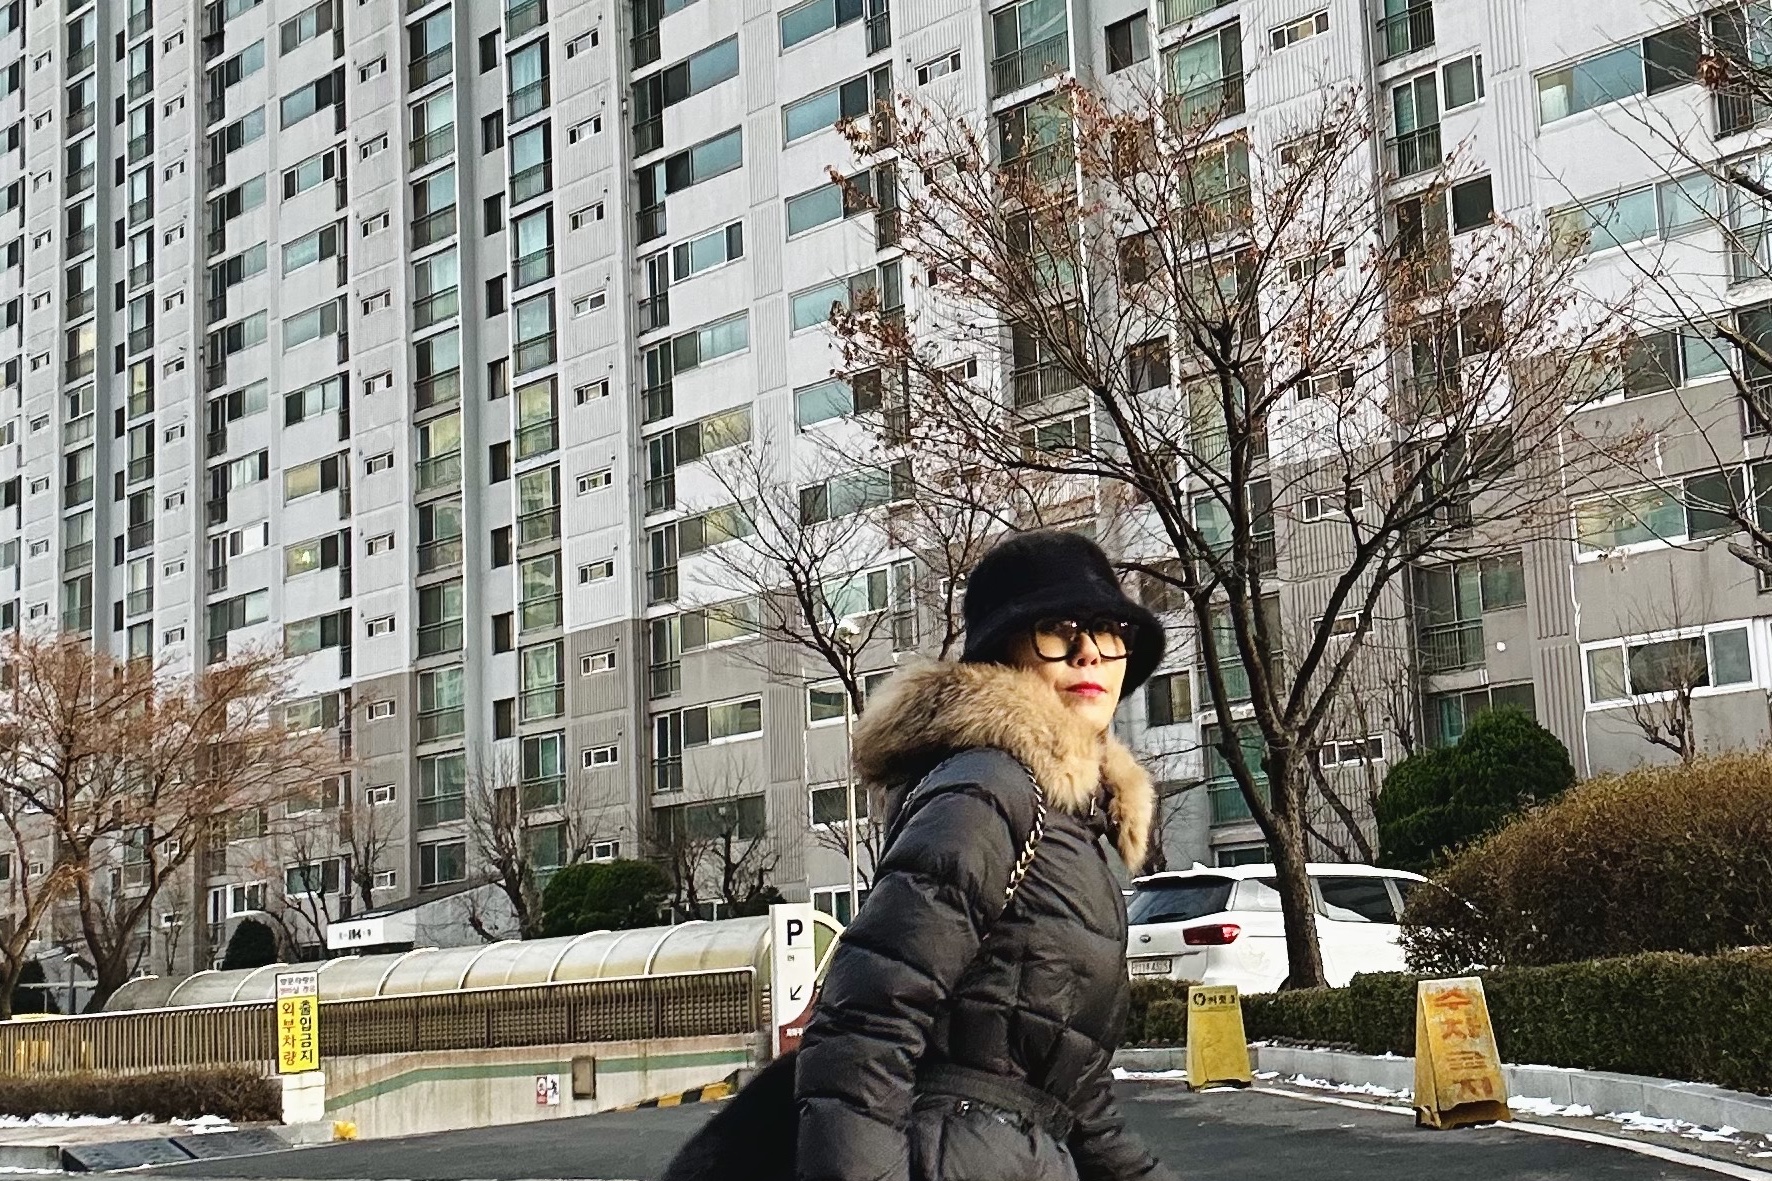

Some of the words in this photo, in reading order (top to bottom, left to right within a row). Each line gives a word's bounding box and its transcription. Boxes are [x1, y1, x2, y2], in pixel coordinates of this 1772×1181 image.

[787, 919, 804, 946] P
[282, 1001, 296, 1066] 외부차량
[299, 999, 313, 1064] 출입금지
